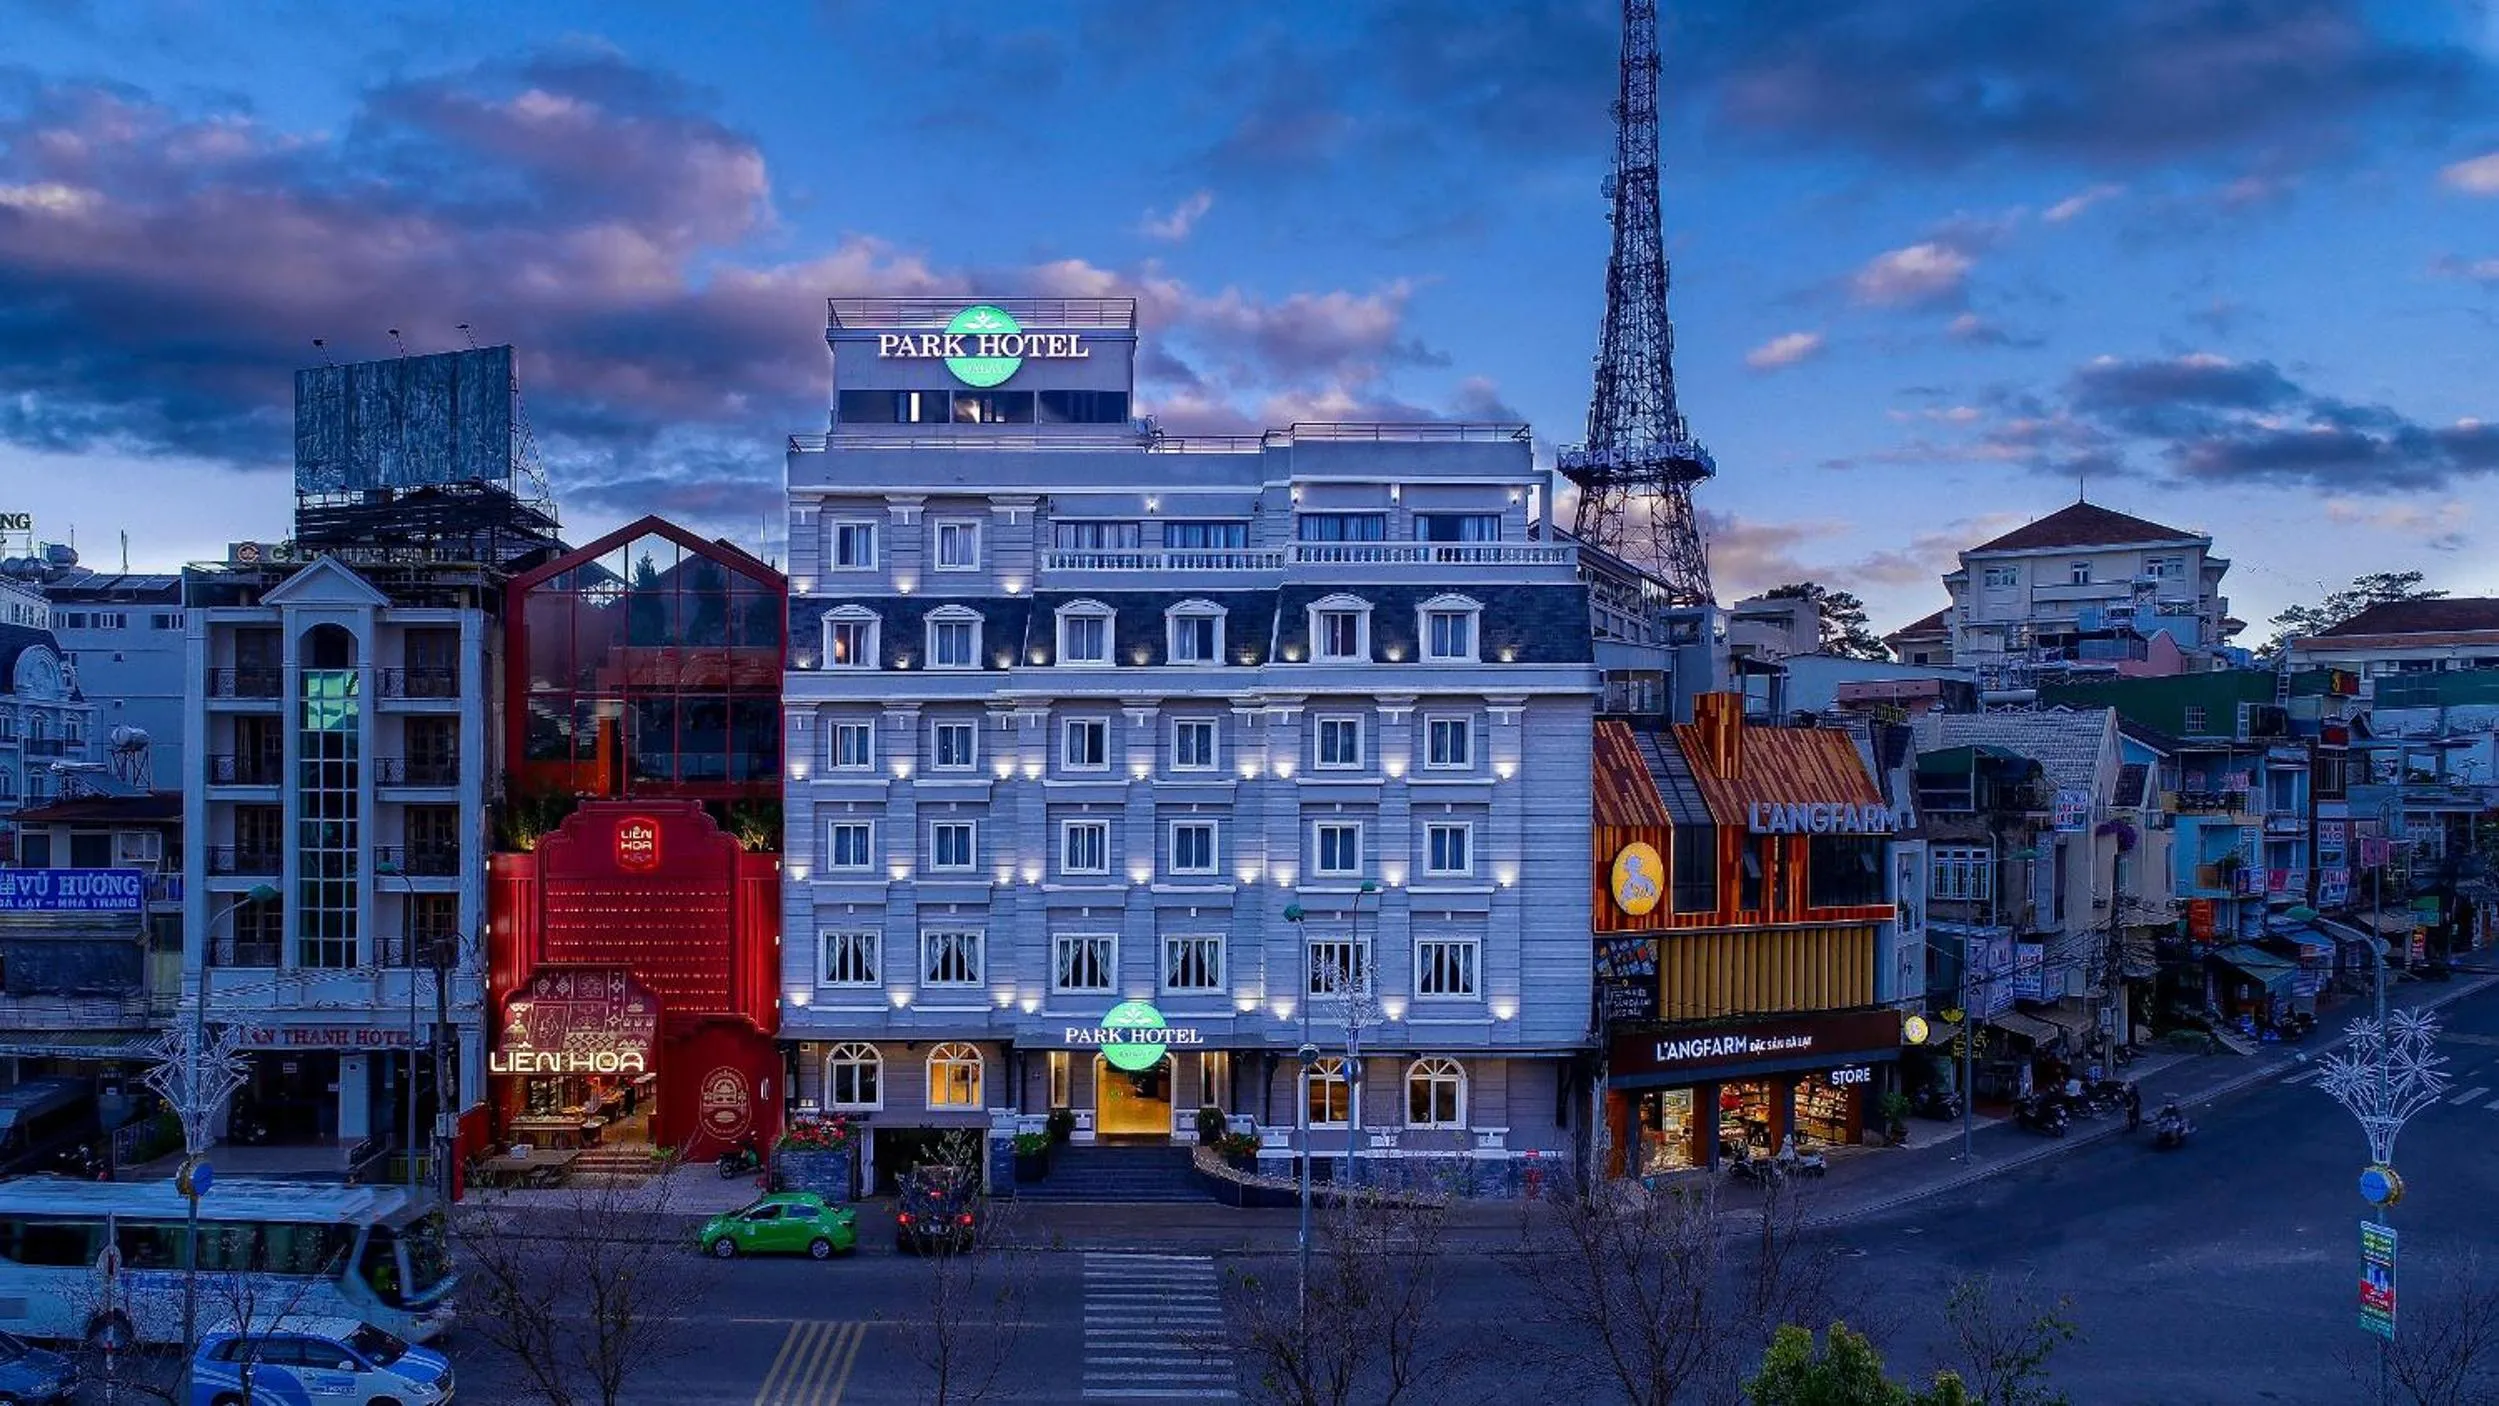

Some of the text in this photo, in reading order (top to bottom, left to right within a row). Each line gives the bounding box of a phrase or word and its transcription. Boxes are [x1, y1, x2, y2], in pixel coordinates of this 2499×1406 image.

[878, 334, 1089, 358] PARK HOTEL
[620, 840, 653, 850] HOA
[58, 872, 139, 896] HƯƠNG
[58, 898, 87, 908] NHA
[91, 898, 137, 908] TRANG
[280, 1029, 349, 1045] THANH
[1065, 1027, 1204, 1044] PARK HOTEL
[1656, 1034, 1748, 1062] L'ANGFARM
[569, 1051, 644, 1072] HOA
[1832, 1067, 1871, 1085] STORE
